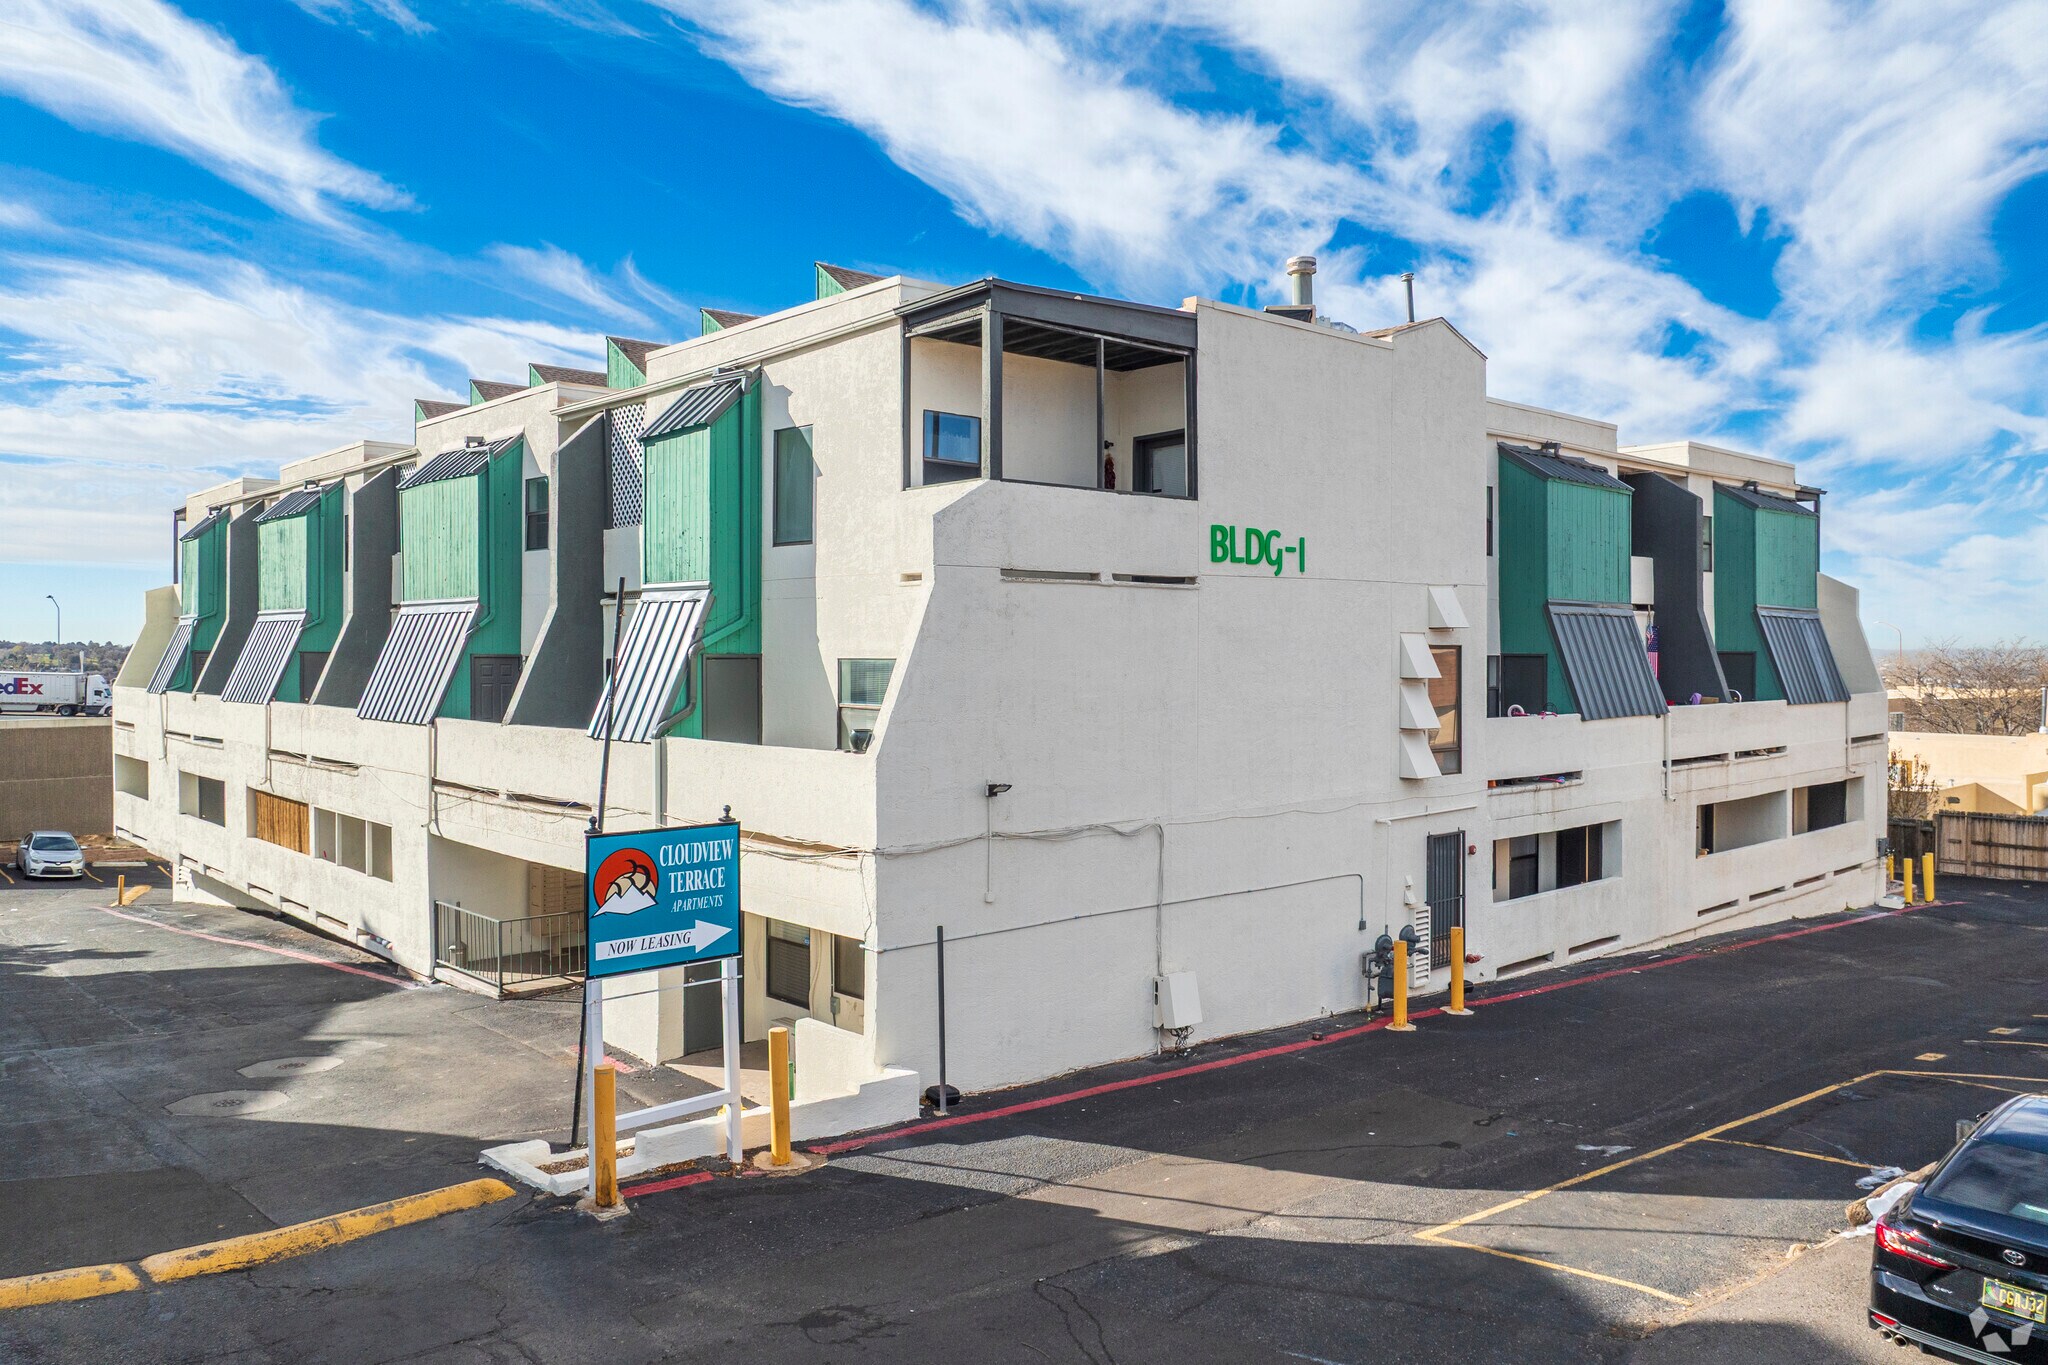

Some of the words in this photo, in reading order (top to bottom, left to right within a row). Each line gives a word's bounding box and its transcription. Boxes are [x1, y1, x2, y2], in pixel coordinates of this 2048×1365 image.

[659, 838, 734, 867] CLOUDVIEW
[668, 866, 726, 894] TERRACE
[670, 894, 724, 913] APARTMENTS
[607, 939, 638, 956] NOW
[640, 931, 692, 951] LEASING
